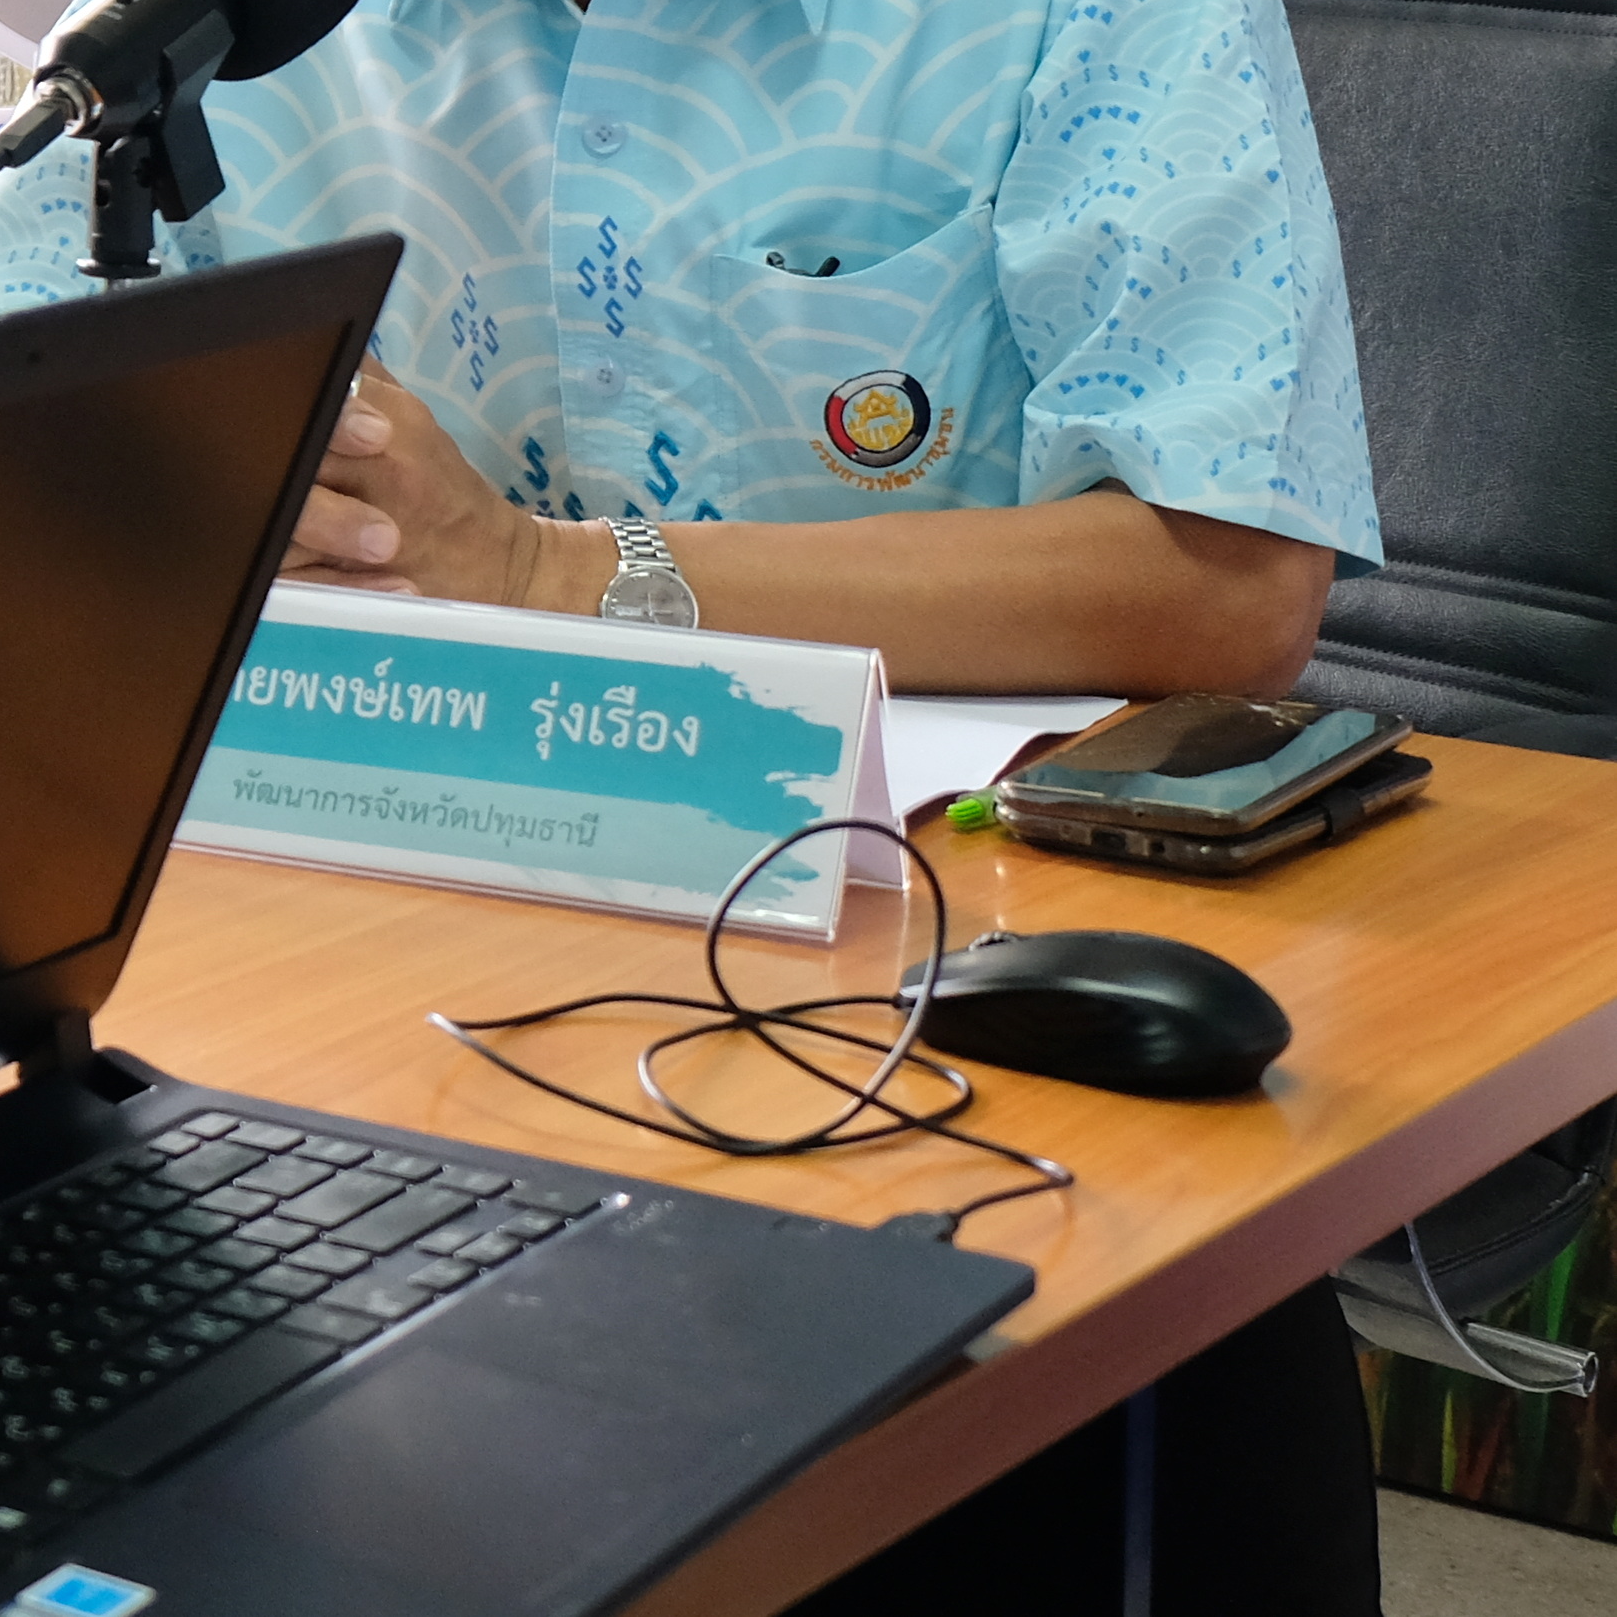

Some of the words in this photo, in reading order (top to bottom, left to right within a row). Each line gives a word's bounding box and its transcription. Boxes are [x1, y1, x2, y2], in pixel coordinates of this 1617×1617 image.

[530, 681, 701, 761] รุ่งเรือง
[232, 769, 600, 848] พัฒนาการจังหวัดปทุมธานี
